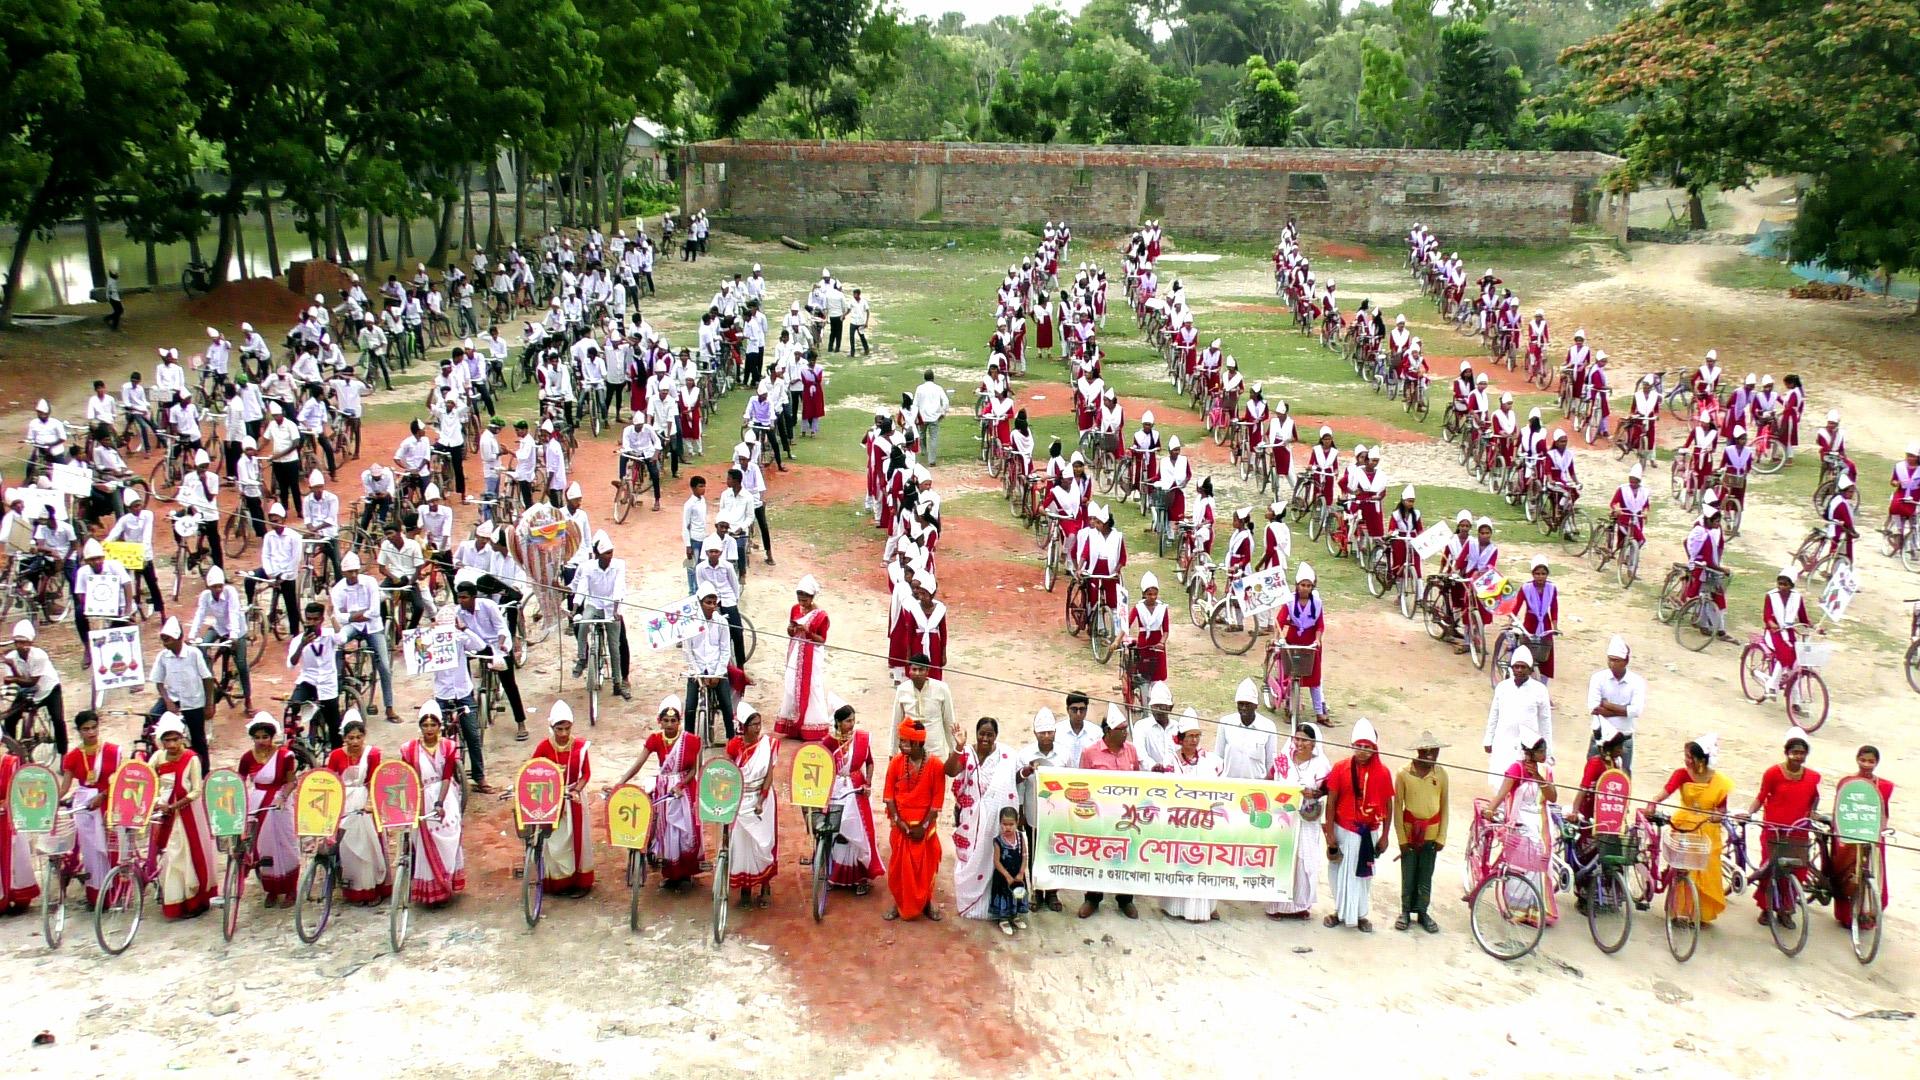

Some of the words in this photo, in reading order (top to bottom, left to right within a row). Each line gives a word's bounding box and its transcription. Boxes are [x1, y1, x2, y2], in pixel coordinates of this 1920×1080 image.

[802, 763, 824, 788] ম
[122, 777, 148, 808] ন
[308, 788, 335, 818] ব
[1097, 785, 1139, 797] এসো
[1146, 787, 1168, 799] হে
[1175, 784, 1235, 801] বৈশাখ
[618, 802, 640, 829] গ
[1115, 803, 1160, 835] শুভ
[1167, 802, 1224, 830] নববর্ষ
[1054, 832, 1130, 861] মঙ্গল
[1139, 839, 1278, 868] শোভাযাত্রা
[1048, 864, 1094, 879] আয়োজনে
[1107, 869, 1150, 883] গুয়াখোলা
[1155, 870, 1194, 885] মাধ্যমিক
[1198, 872, 1239, 890] বিদ্যালয়,
[1243, 873, 1275, 890] নড়াইল
